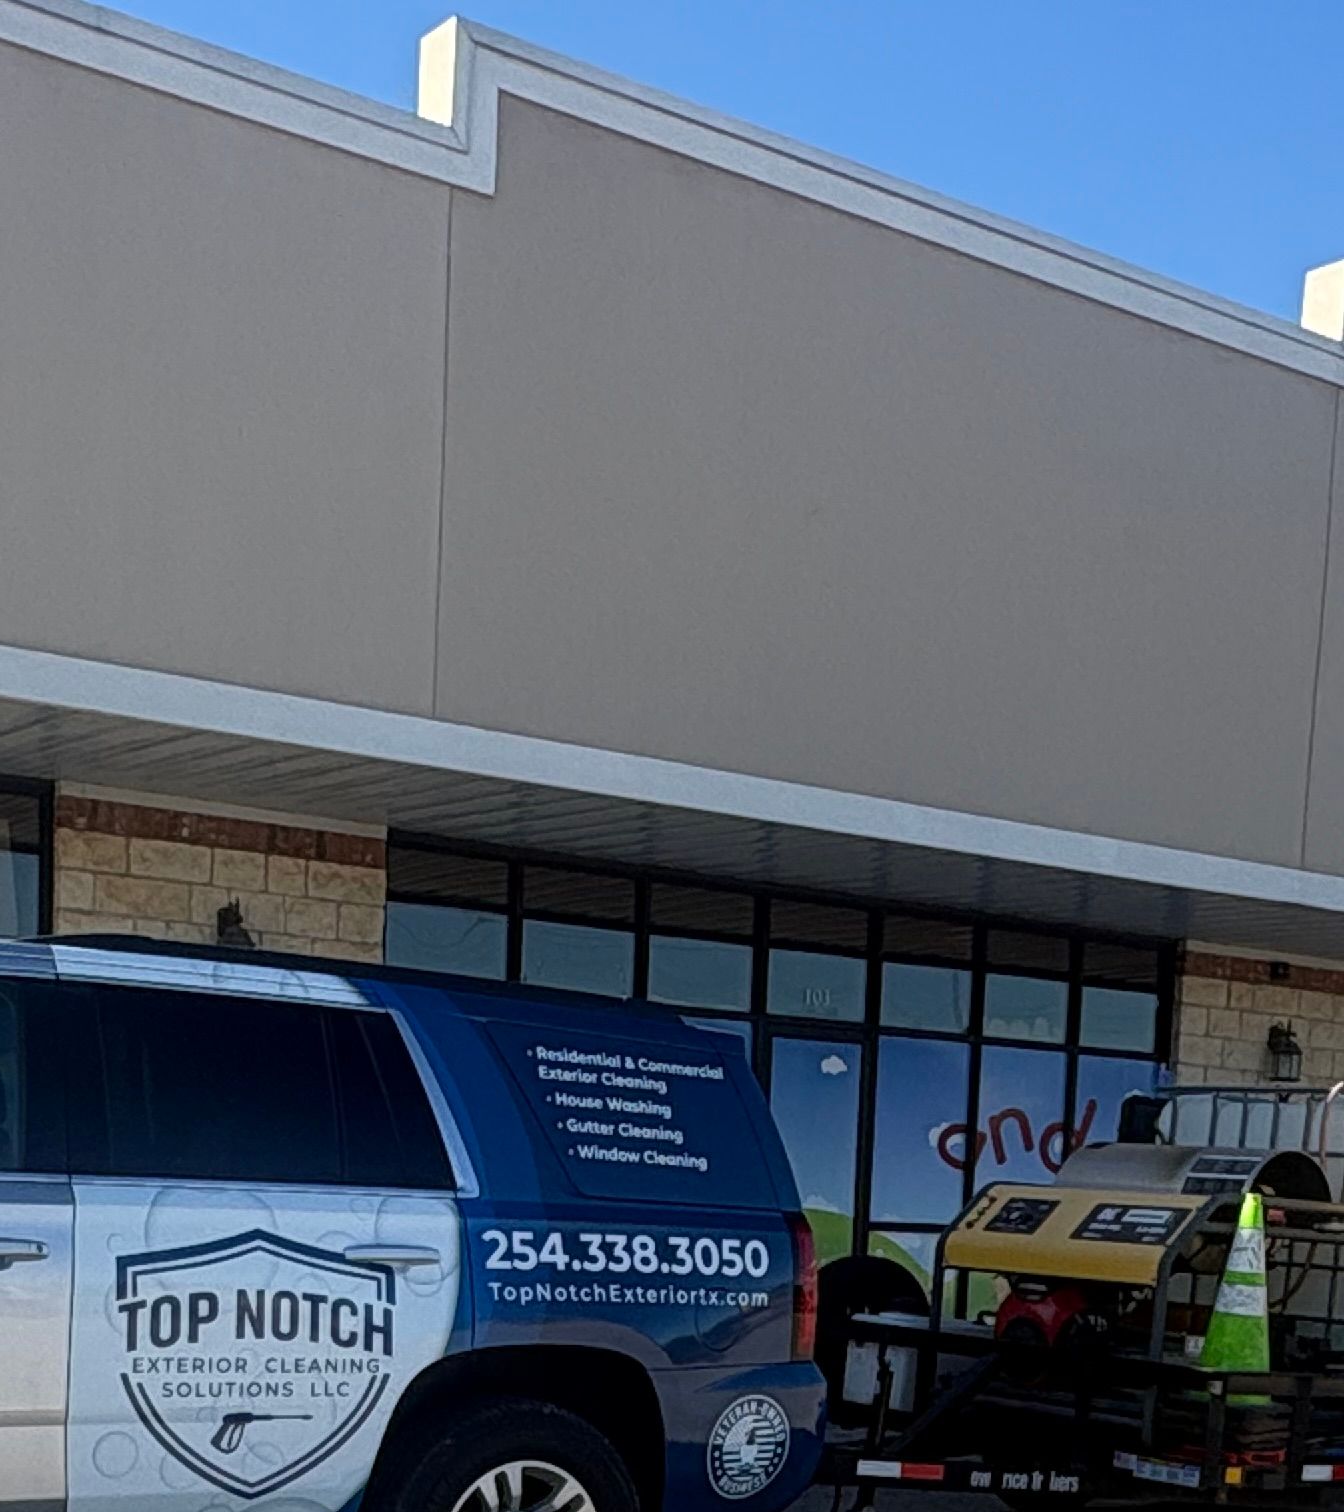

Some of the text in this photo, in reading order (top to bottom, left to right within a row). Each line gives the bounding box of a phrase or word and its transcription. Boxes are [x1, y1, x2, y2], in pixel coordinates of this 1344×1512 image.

[536, 1046, 723, 1080] Residential & Commercial
[538, 1065, 668, 1095] Exterior Cleaning
[555, 1093, 672, 1119] House Washing
[565, 1119, 684, 1145] Gutter Cleaning
[937, 1098, 1097, 1174] and
[577, 1146, 708, 1172] Window Cleaning
[481, 1229, 769, 1278] 254.338.3050
[487, 1281, 769, 1307] TopNotchExteriortx.com
[118, 1288, 394, 1356] TOP NOTCH
[132, 1357, 380, 1374] EXTERIOR CLEANING
[162, 1382, 350, 1398] SOLUTIONS LLC
